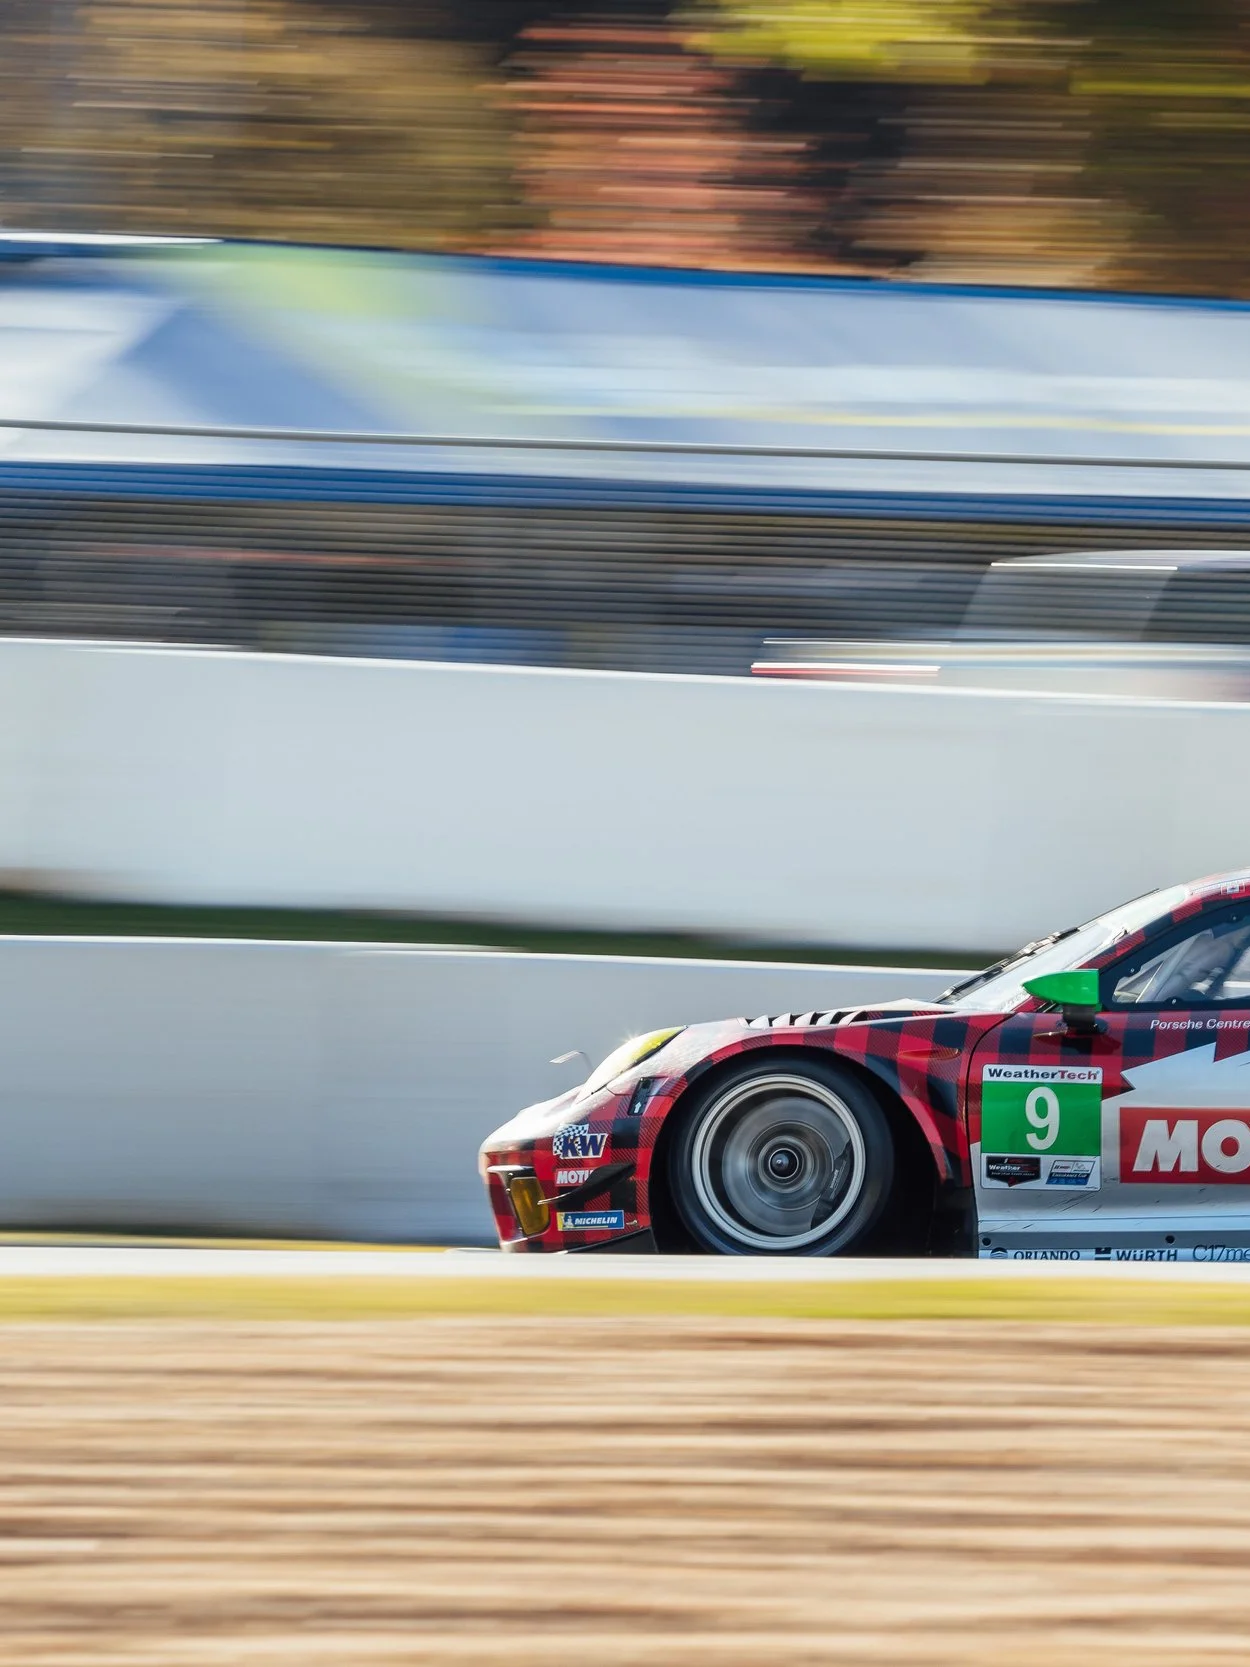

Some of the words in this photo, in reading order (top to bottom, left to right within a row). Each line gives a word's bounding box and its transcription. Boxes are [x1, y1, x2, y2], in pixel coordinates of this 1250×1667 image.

[1150, 1019, 1203, 1030] Porsche
[1206, 1018, 1250, 1029] Centre
[988, 1068, 1098, 1080] WeatherTech
[1025, 1086, 1060, 1151] 9
[562, 1135, 605, 1157] KW
[556, 1170, 594, 1185] MOT
[575, 1216, 618, 1226] MICHELIN
[1014, 1250, 1081, 1260] ORLANDO
